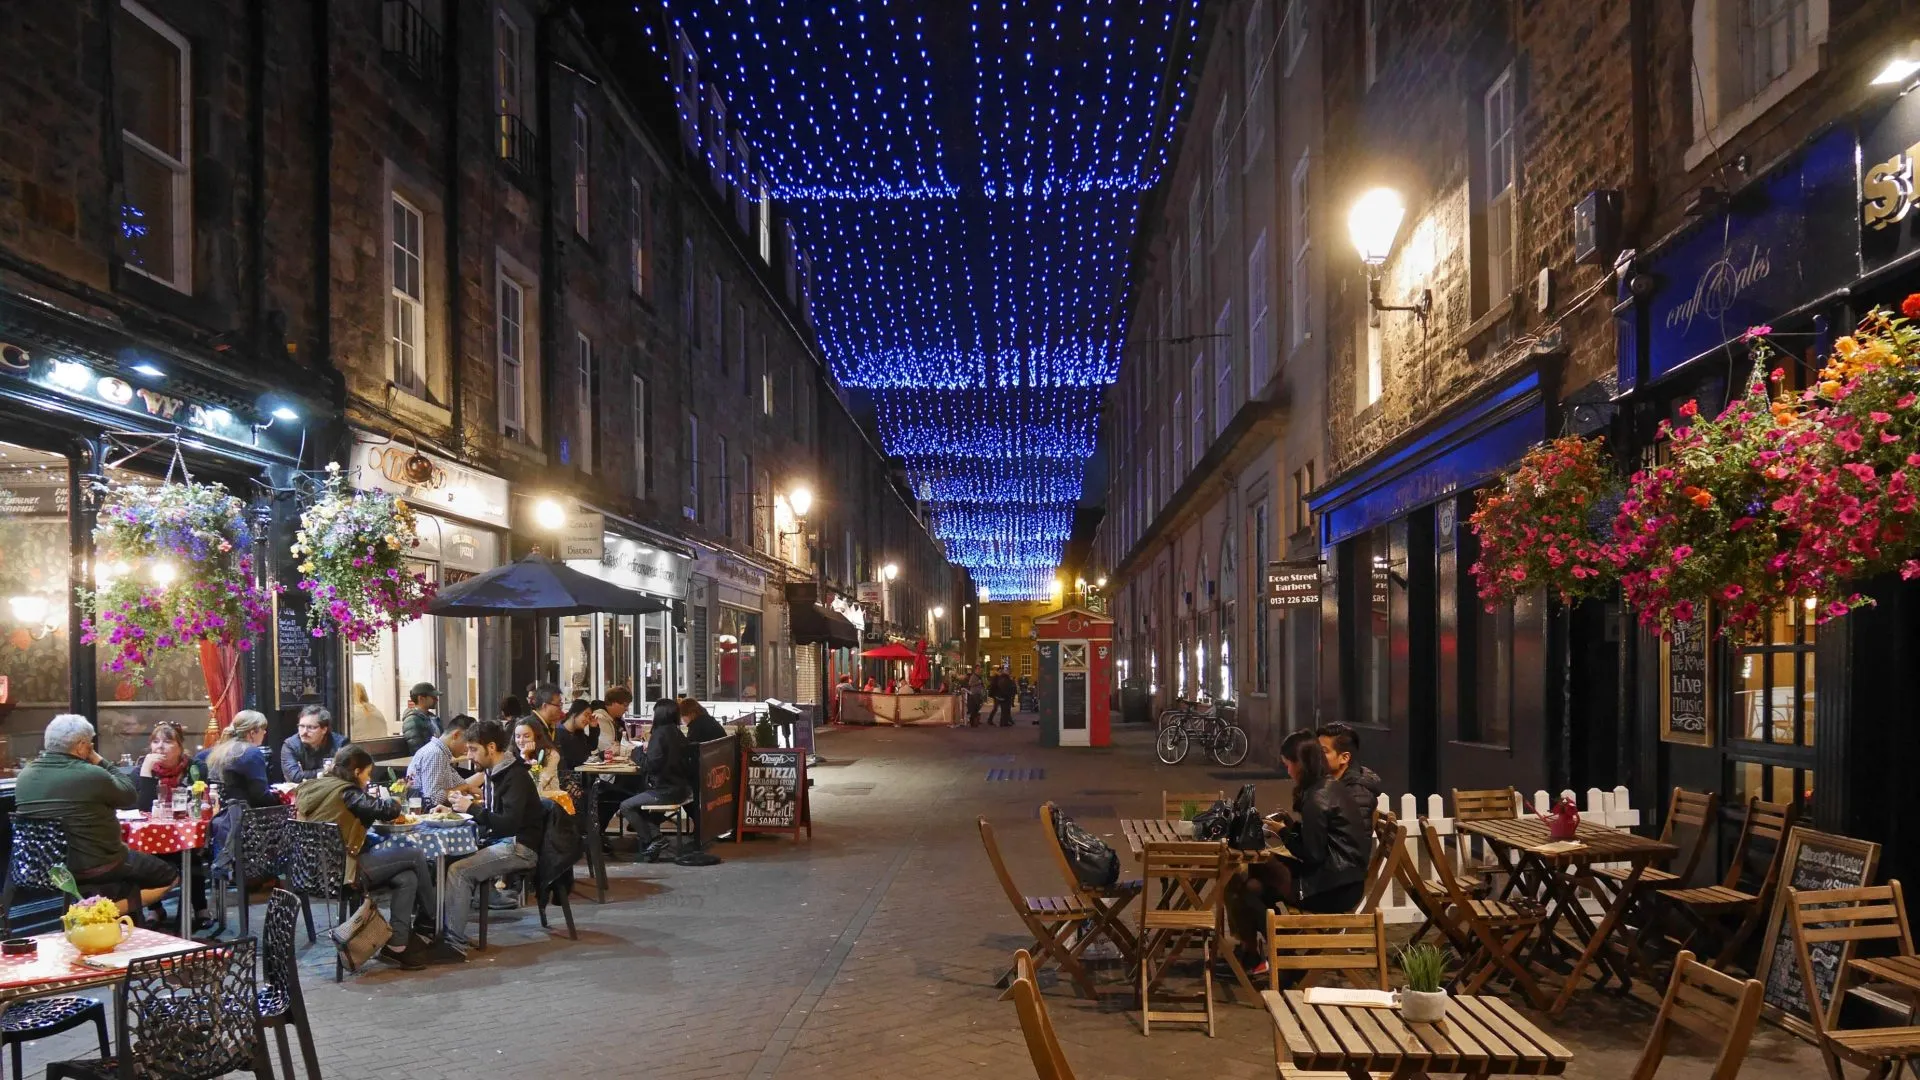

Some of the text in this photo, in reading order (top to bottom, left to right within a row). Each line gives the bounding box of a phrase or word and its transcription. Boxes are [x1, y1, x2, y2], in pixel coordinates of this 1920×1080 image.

[1290, 573, 1318, 581] Street
[1276, 584, 1312, 592] Barbers
[1270, 595, 1319, 605] 0131 226 2625
[1673, 674, 1702, 694] Live
[758, 753, 787, 766] Dough
[765, 767, 797, 778] PIZZA
